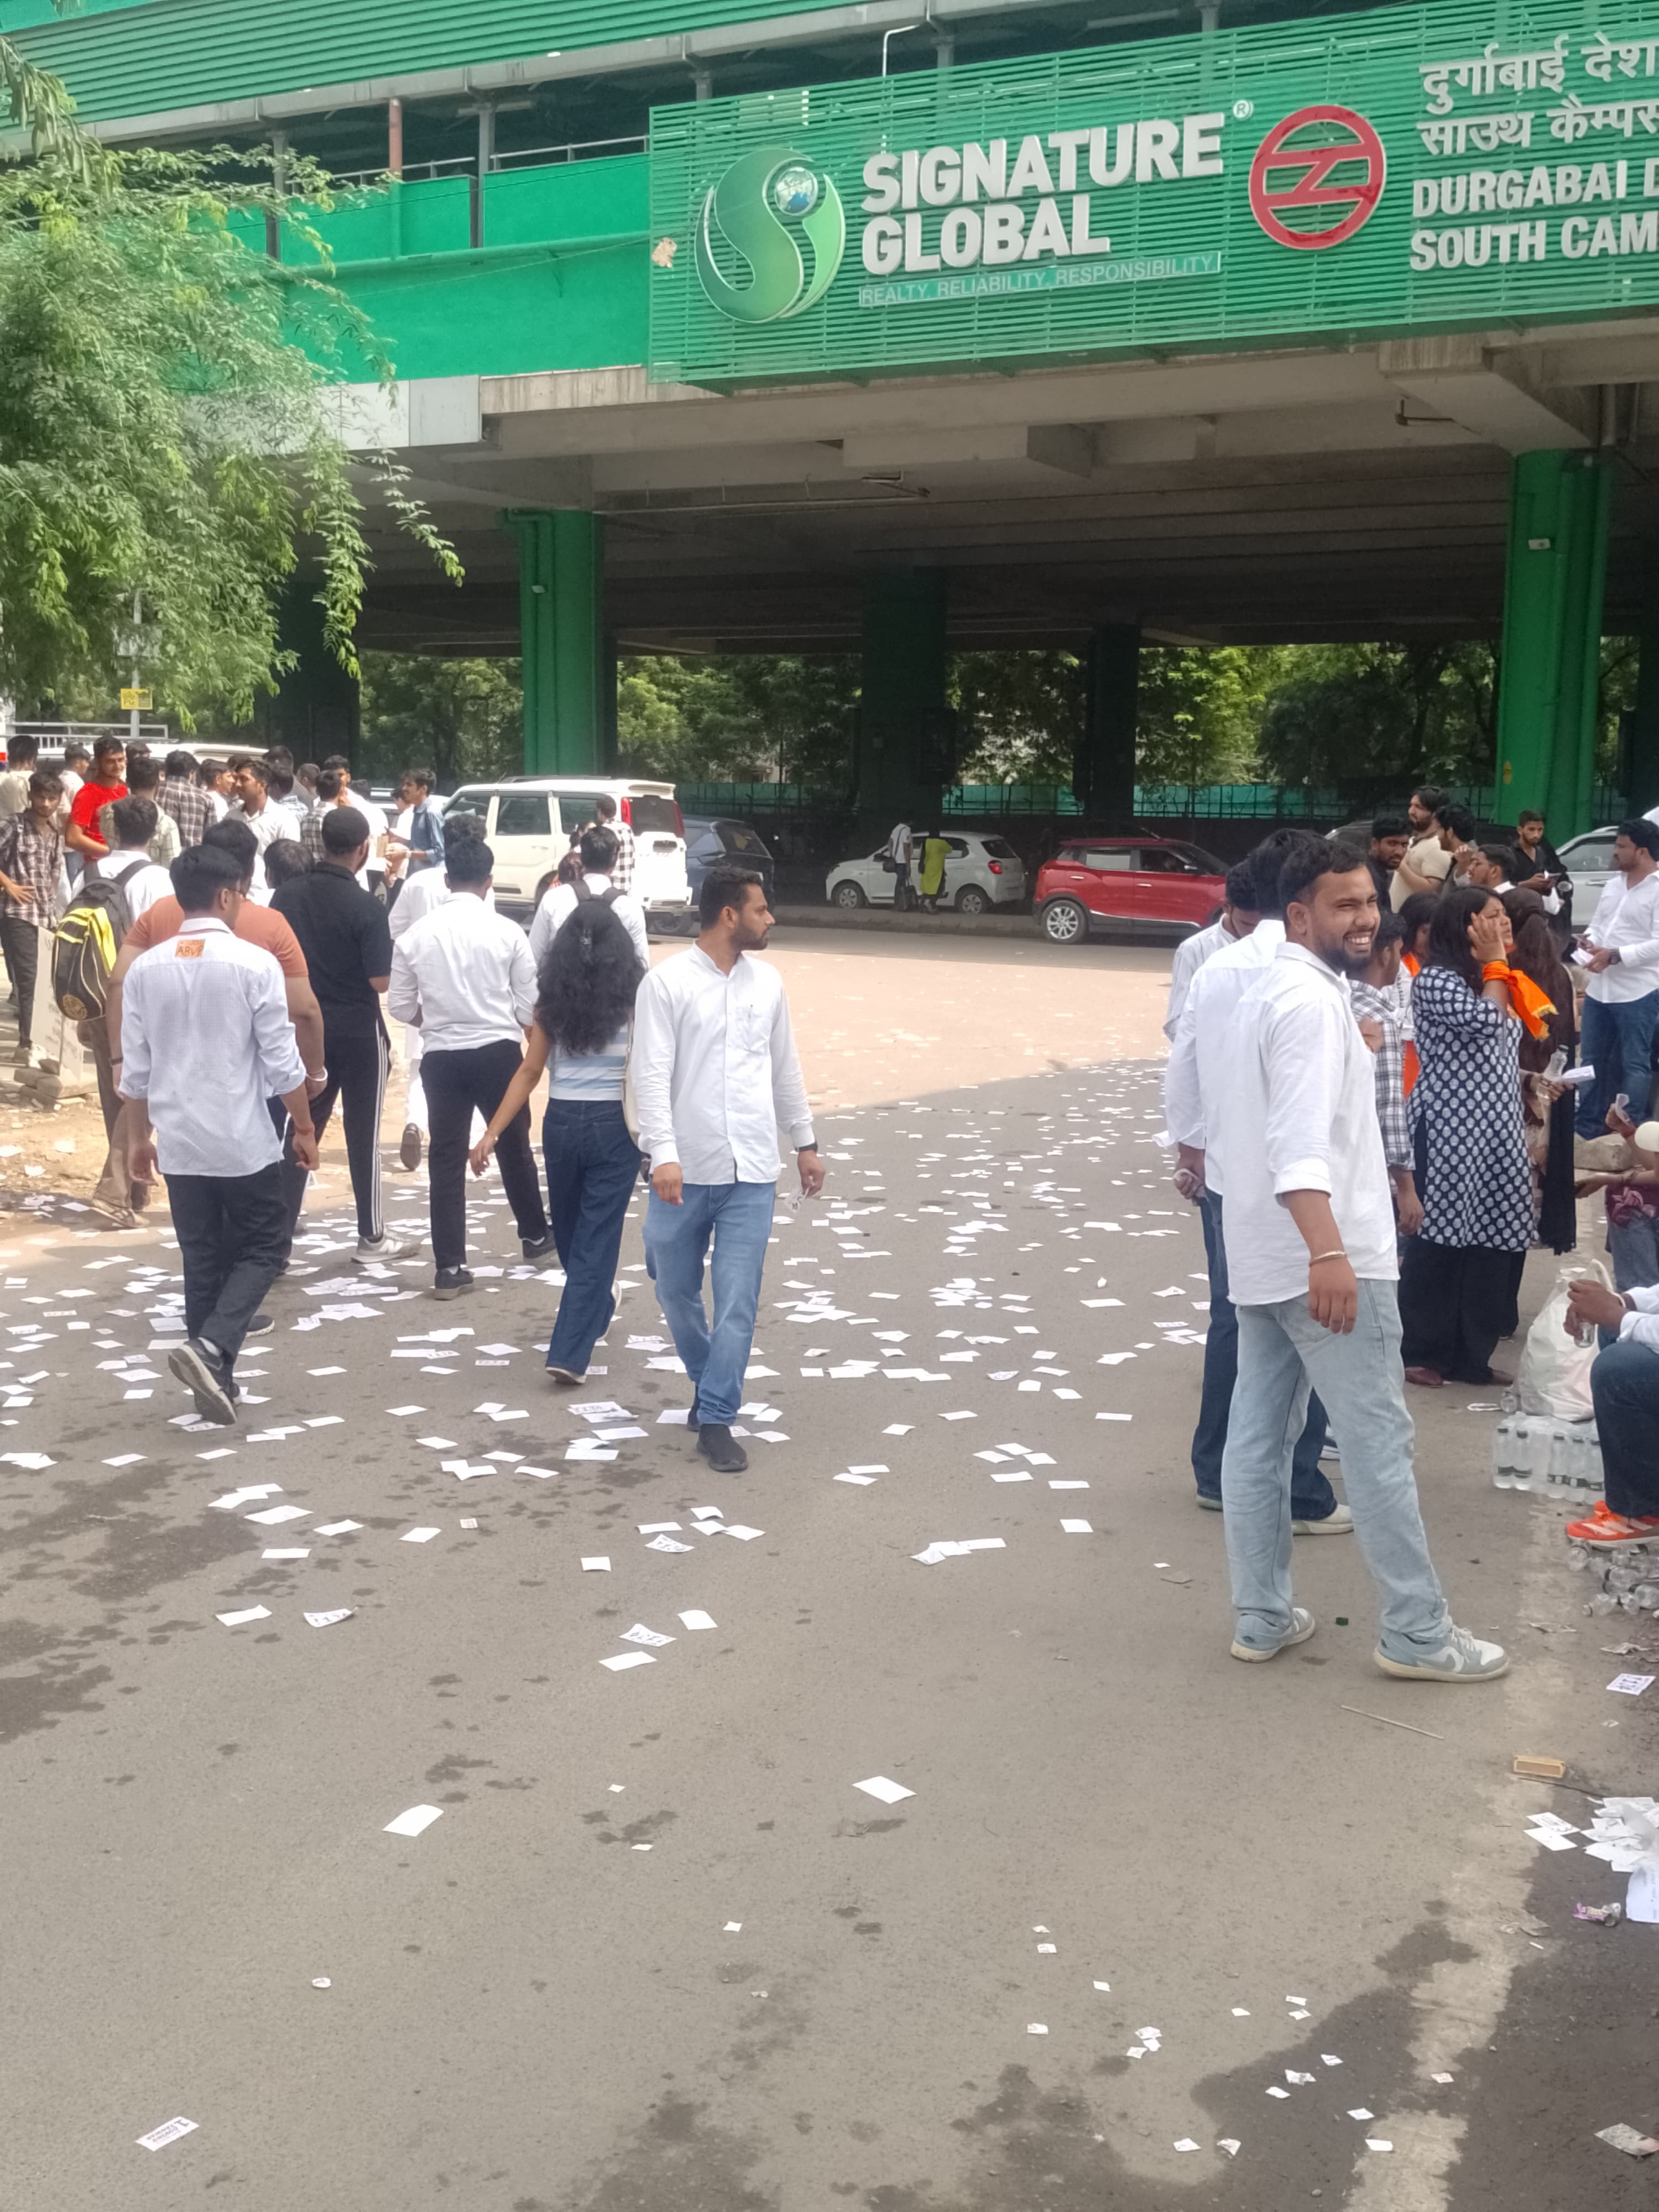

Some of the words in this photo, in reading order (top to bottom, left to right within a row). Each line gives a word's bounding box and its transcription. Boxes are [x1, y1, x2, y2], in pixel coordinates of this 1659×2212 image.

[1419, 34, 1569, 114] दुर्गाबाई
[860, 112, 1225, 213] SIGNATURE
[1416, 112, 1535, 155] साउथ
[1412, 159, 1627, 217] DURGABAI
[862, 194, 1110, 275] GLOBAL
[1410, 220, 1546, 270] SOUTH
